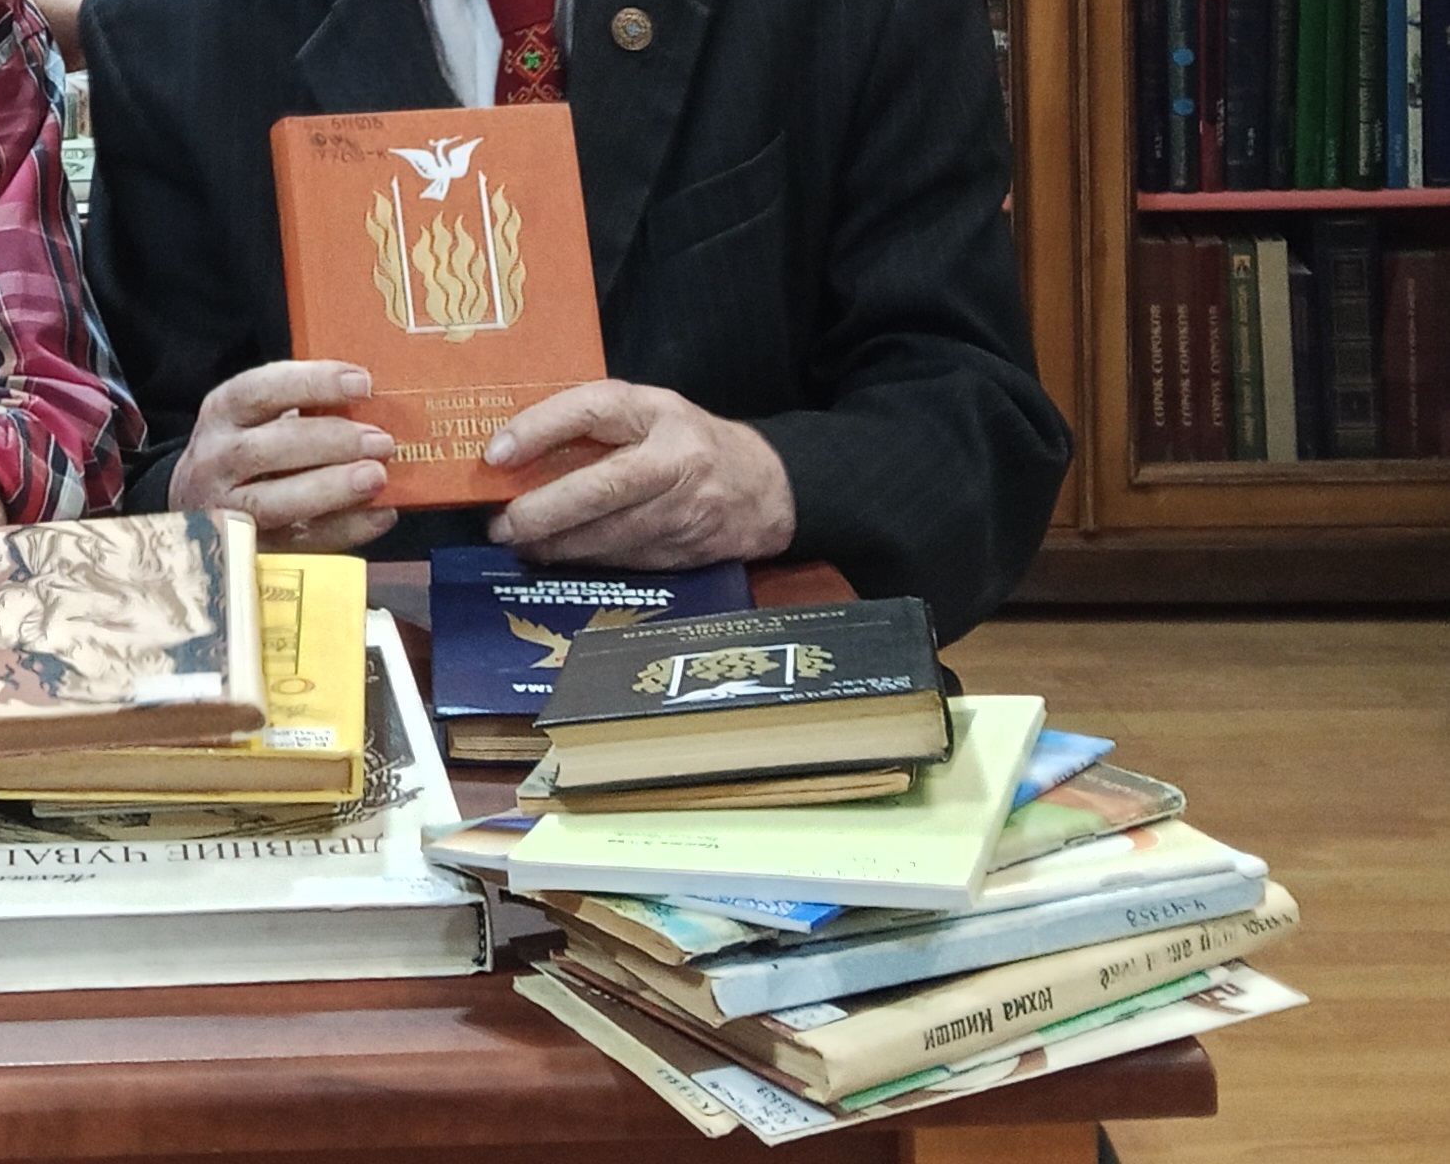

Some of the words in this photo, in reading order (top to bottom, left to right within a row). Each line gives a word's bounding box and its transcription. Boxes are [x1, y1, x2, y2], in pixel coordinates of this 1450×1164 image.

[390, 443, 446, 465] ТИЦА
[166, 832, 383, 864] ДРЕВНИЕ
[1001, 986, 1054, 1024] Юхма
[922, 1008, 995, 1053] Мишши
